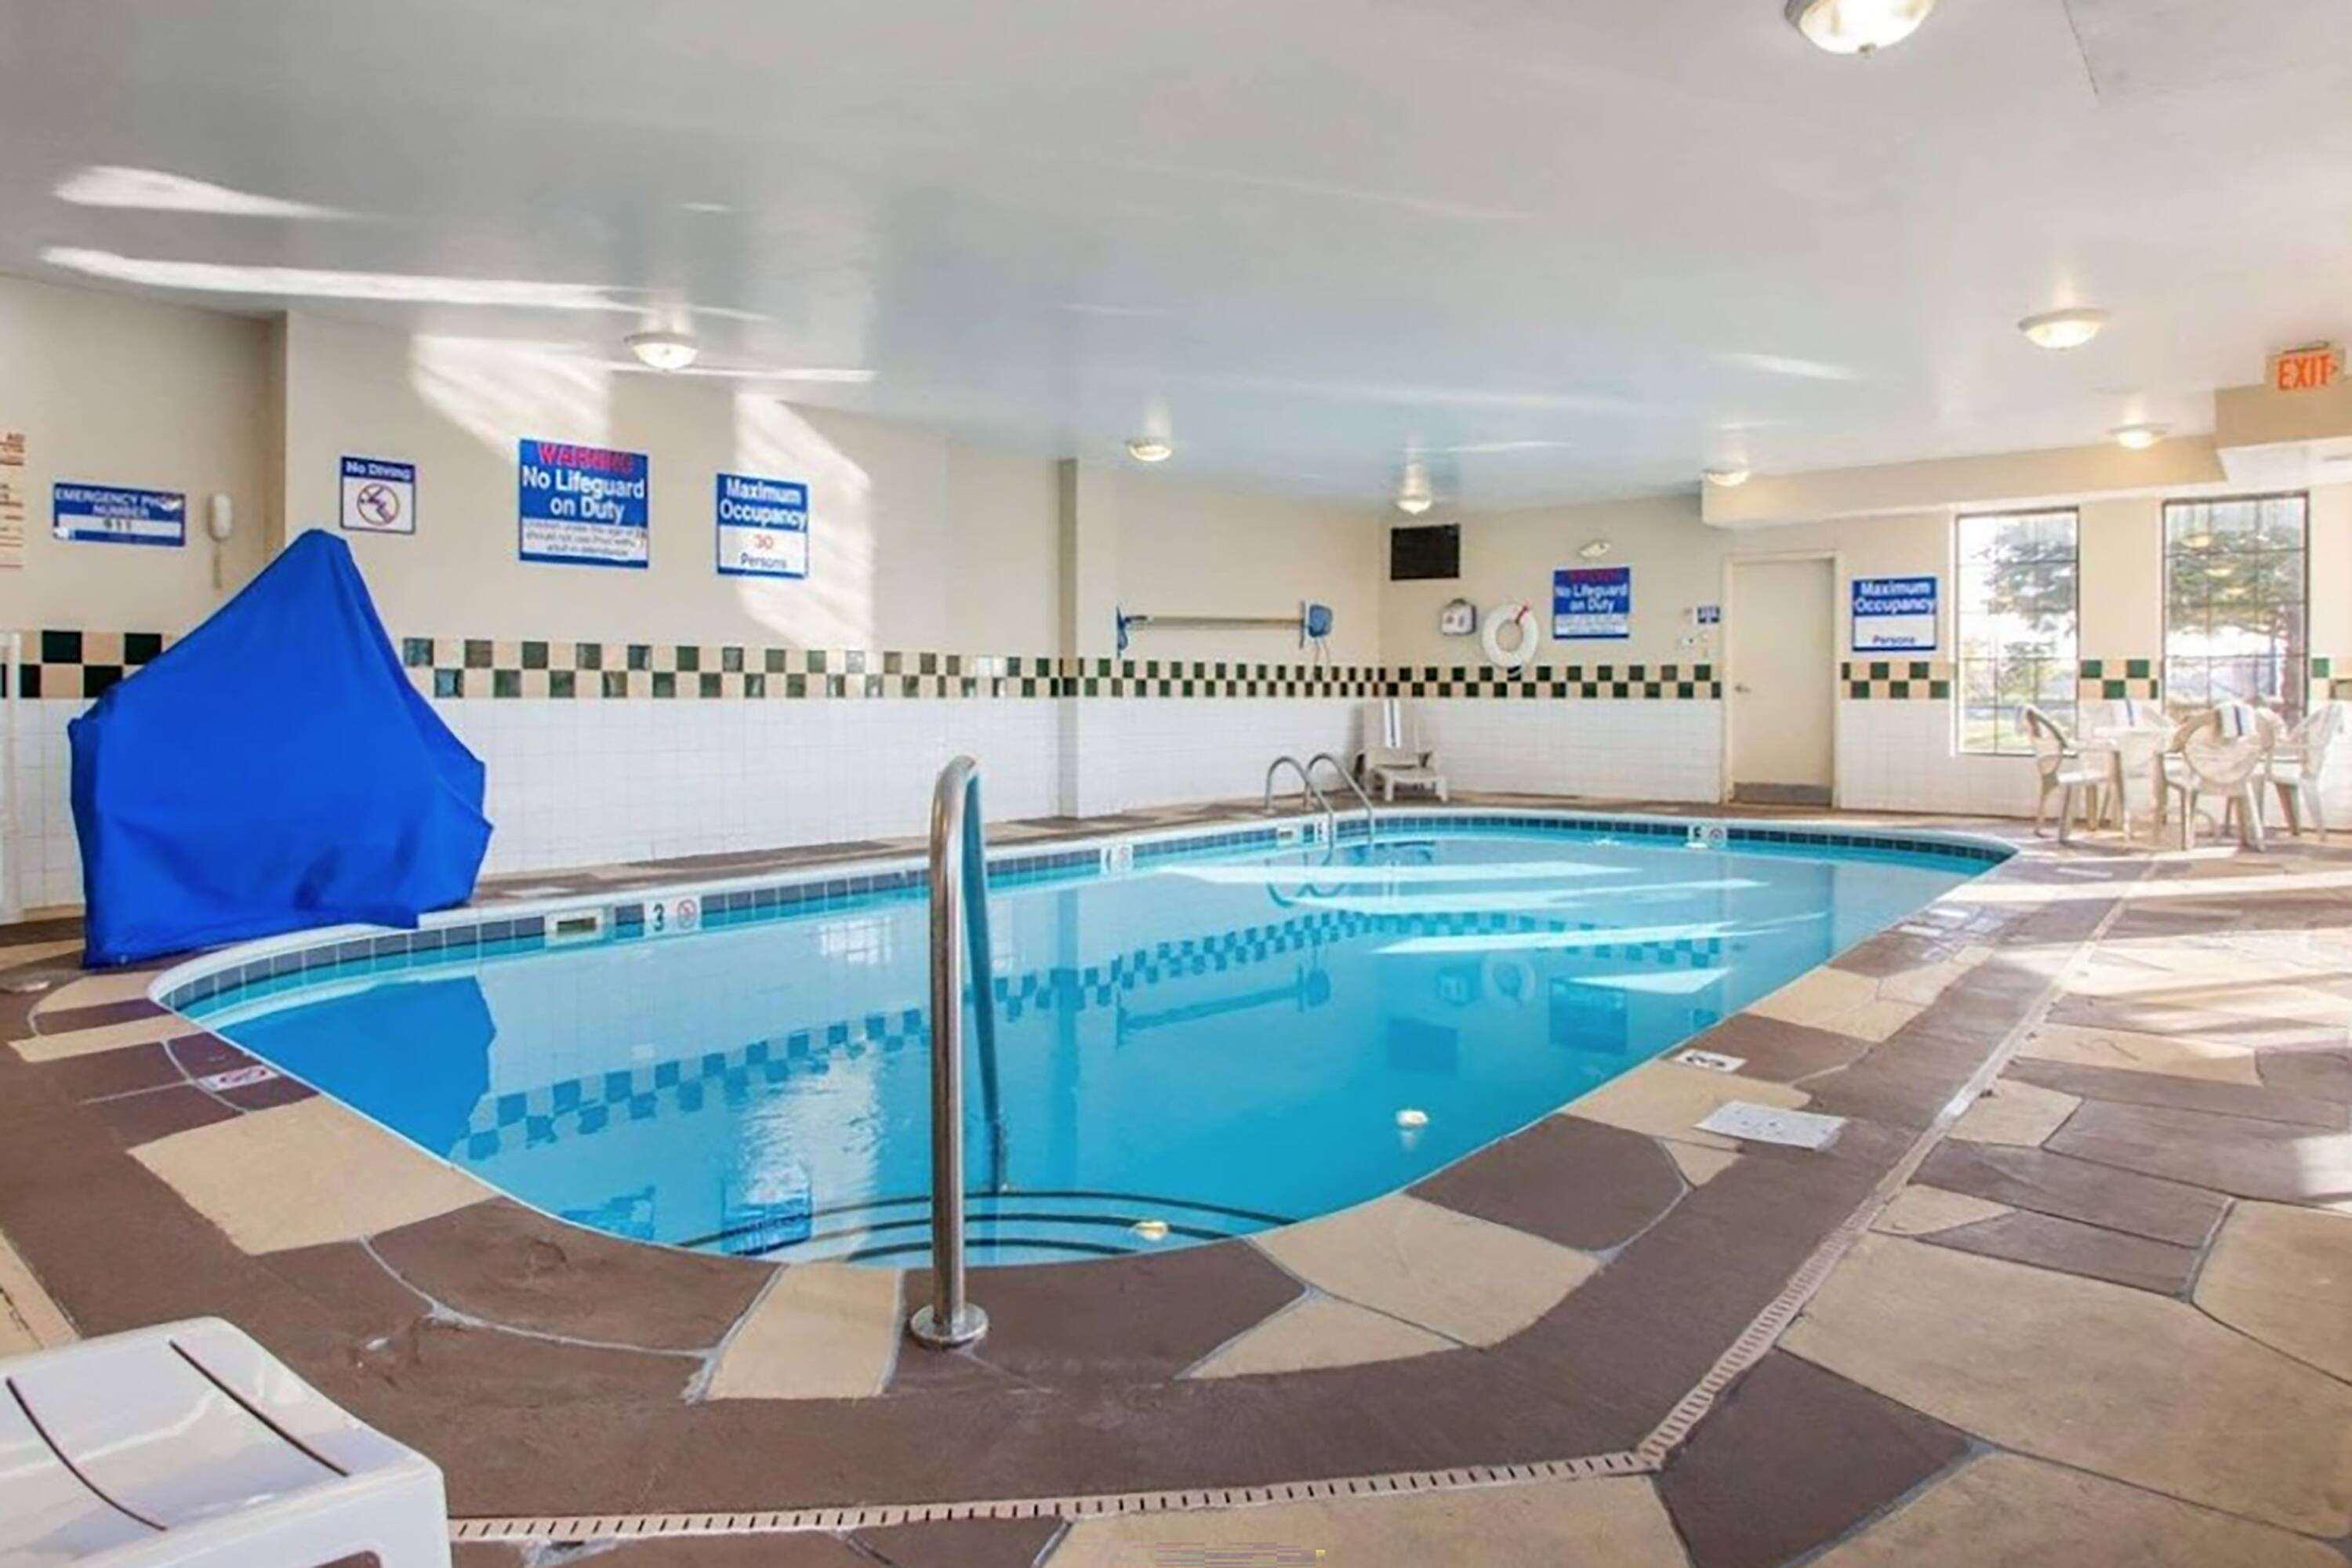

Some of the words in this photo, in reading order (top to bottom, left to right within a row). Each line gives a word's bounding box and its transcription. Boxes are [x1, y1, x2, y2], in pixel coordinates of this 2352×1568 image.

[2278, 354, 2332, 390] EXIT
[346, 460, 366, 474] No
[522, 466, 550, 489] No
[556, 469, 645, 499] Lifeguard
[726, 477, 801, 506] Maximum
[56, 488, 137, 507] EMERGENCY
[92, 503, 150, 520] NUMBER
[550, 496, 576, 516] on
[580, 496, 625, 526] Duty
[720, 498, 806, 531] Occupancy
[755, 534, 773, 550] 30
[740, 552, 787, 569] Persons
[1573, 583, 1627, 599] Lifeguard
[1860, 581, 1931, 596] Maximum
[1570, 601, 1585, 612] on
[1588, 599, 1615, 615] Duty
[1855, 597, 1934, 615] Occupancy
[653, 903, 665, 931] 3
